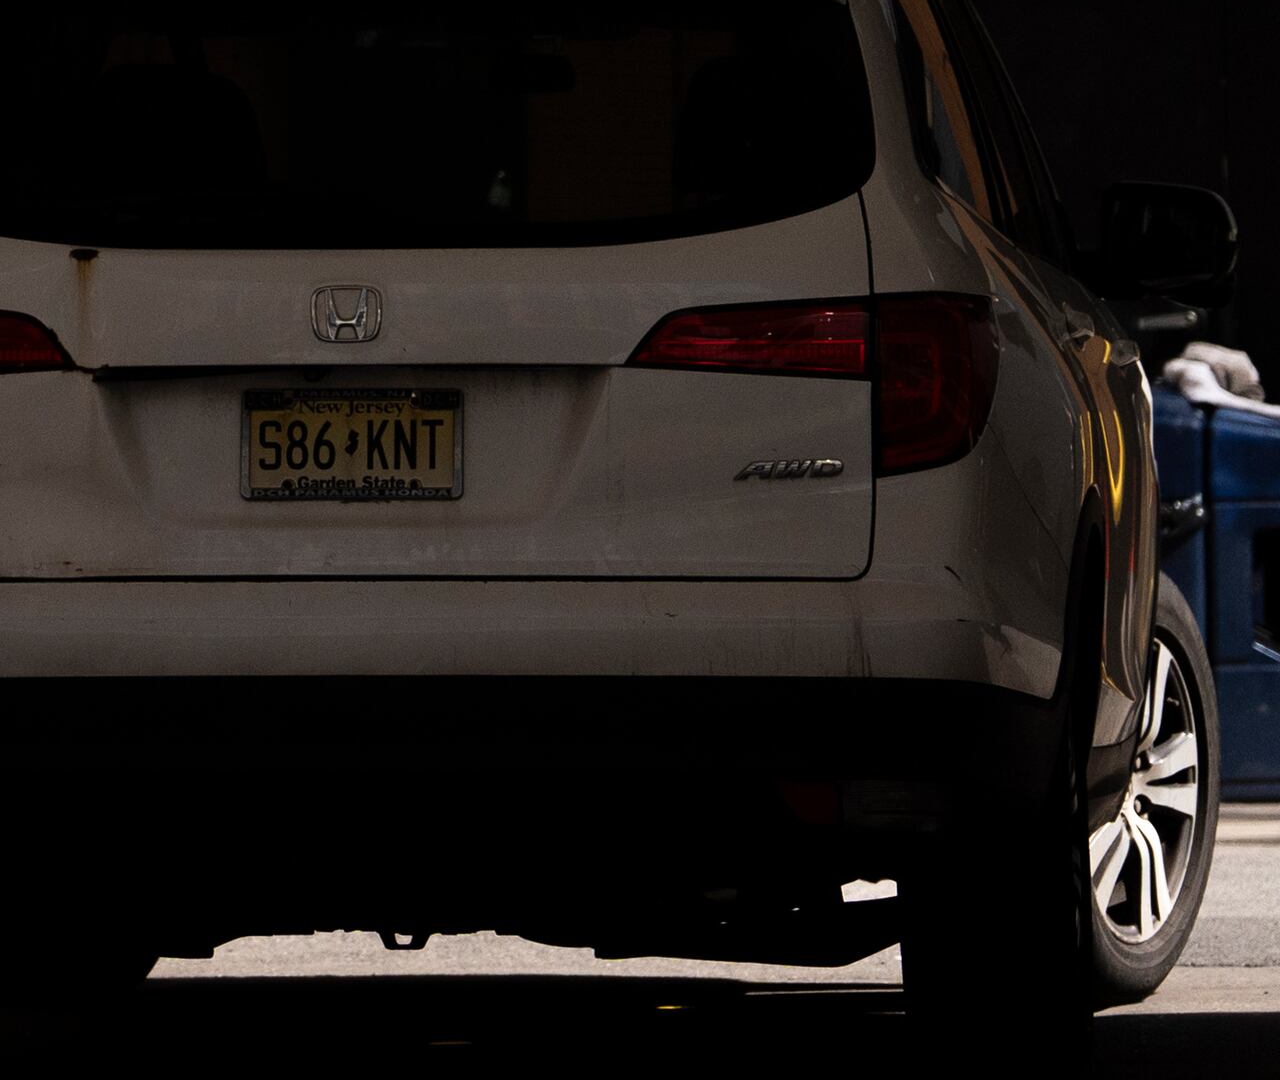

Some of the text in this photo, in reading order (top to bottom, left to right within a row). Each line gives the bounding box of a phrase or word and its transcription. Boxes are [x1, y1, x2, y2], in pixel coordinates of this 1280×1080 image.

[298, 399, 406, 417] New Jersey
[259, 420, 444, 470] S86 KNT
[734, 459, 844, 481] AWD
[297, 476, 406, 489] Garden State
[252, 488, 451, 497] DCH PARAMUS HONDA
